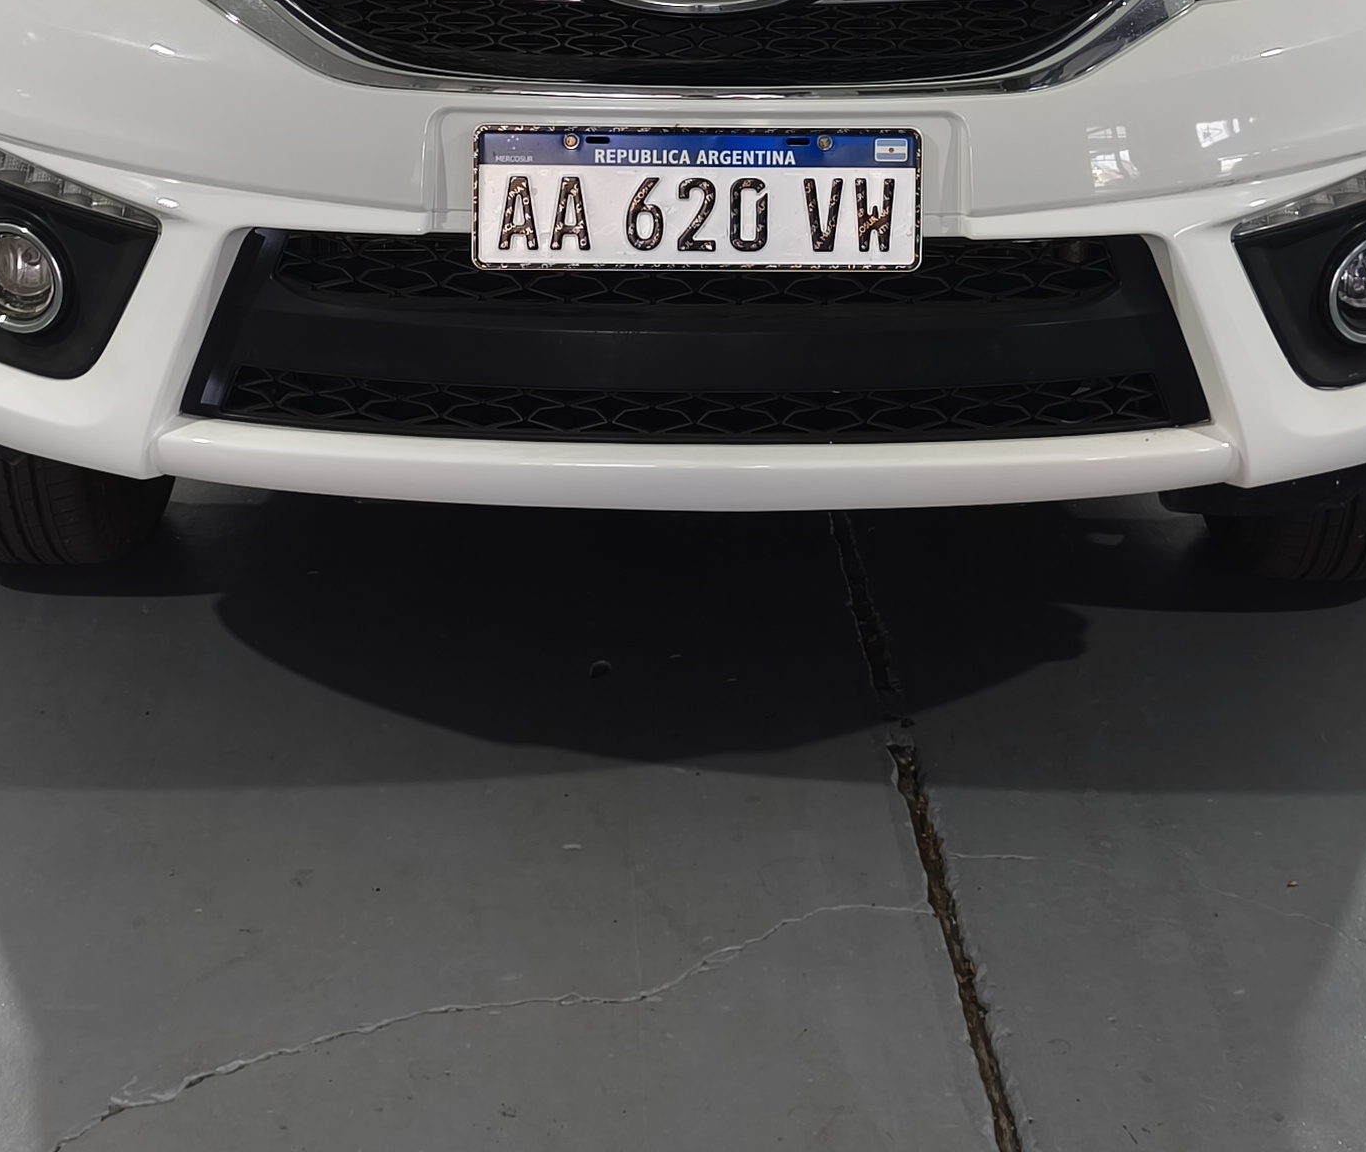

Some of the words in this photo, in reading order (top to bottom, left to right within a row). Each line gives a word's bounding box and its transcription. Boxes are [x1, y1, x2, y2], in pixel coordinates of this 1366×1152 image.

[495, 155, 534, 163] MERCOSUR
[594, 148, 691, 165] REPUBLICA
[695, 149, 796, 165] ARGENTINA
[497, 175, 591, 251] AA
[625, 176, 770, 252] 620
[802, 177, 897, 253] VW
